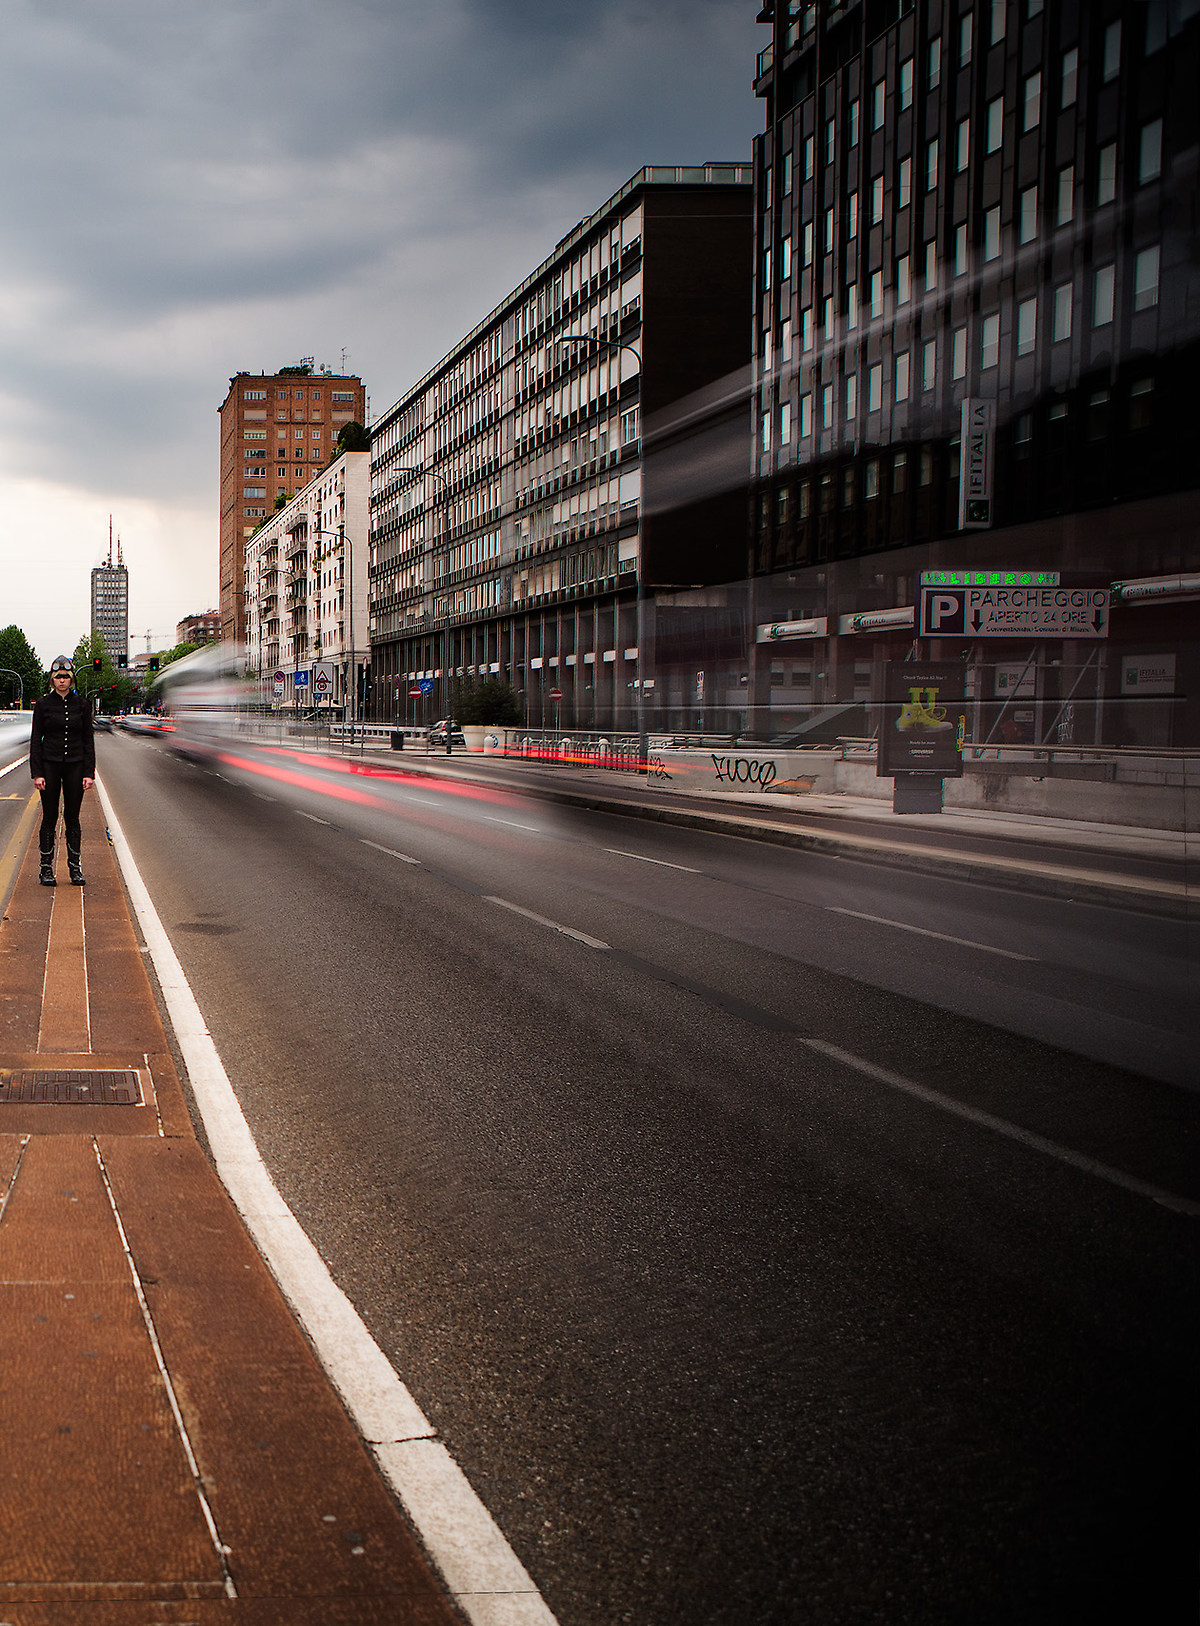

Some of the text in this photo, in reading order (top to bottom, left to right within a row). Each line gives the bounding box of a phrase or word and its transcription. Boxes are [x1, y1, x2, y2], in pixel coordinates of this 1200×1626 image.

[969, 405, 985, 495] IFITALIA
[950, 572, 1031, 585] LIBERO
[969, 590, 1106, 607] PARCHEGGIO
[930, 595, 959, 630] P
[988, 611, 1039, 624] APERTO
[1061, 611, 1087, 624] ORE
